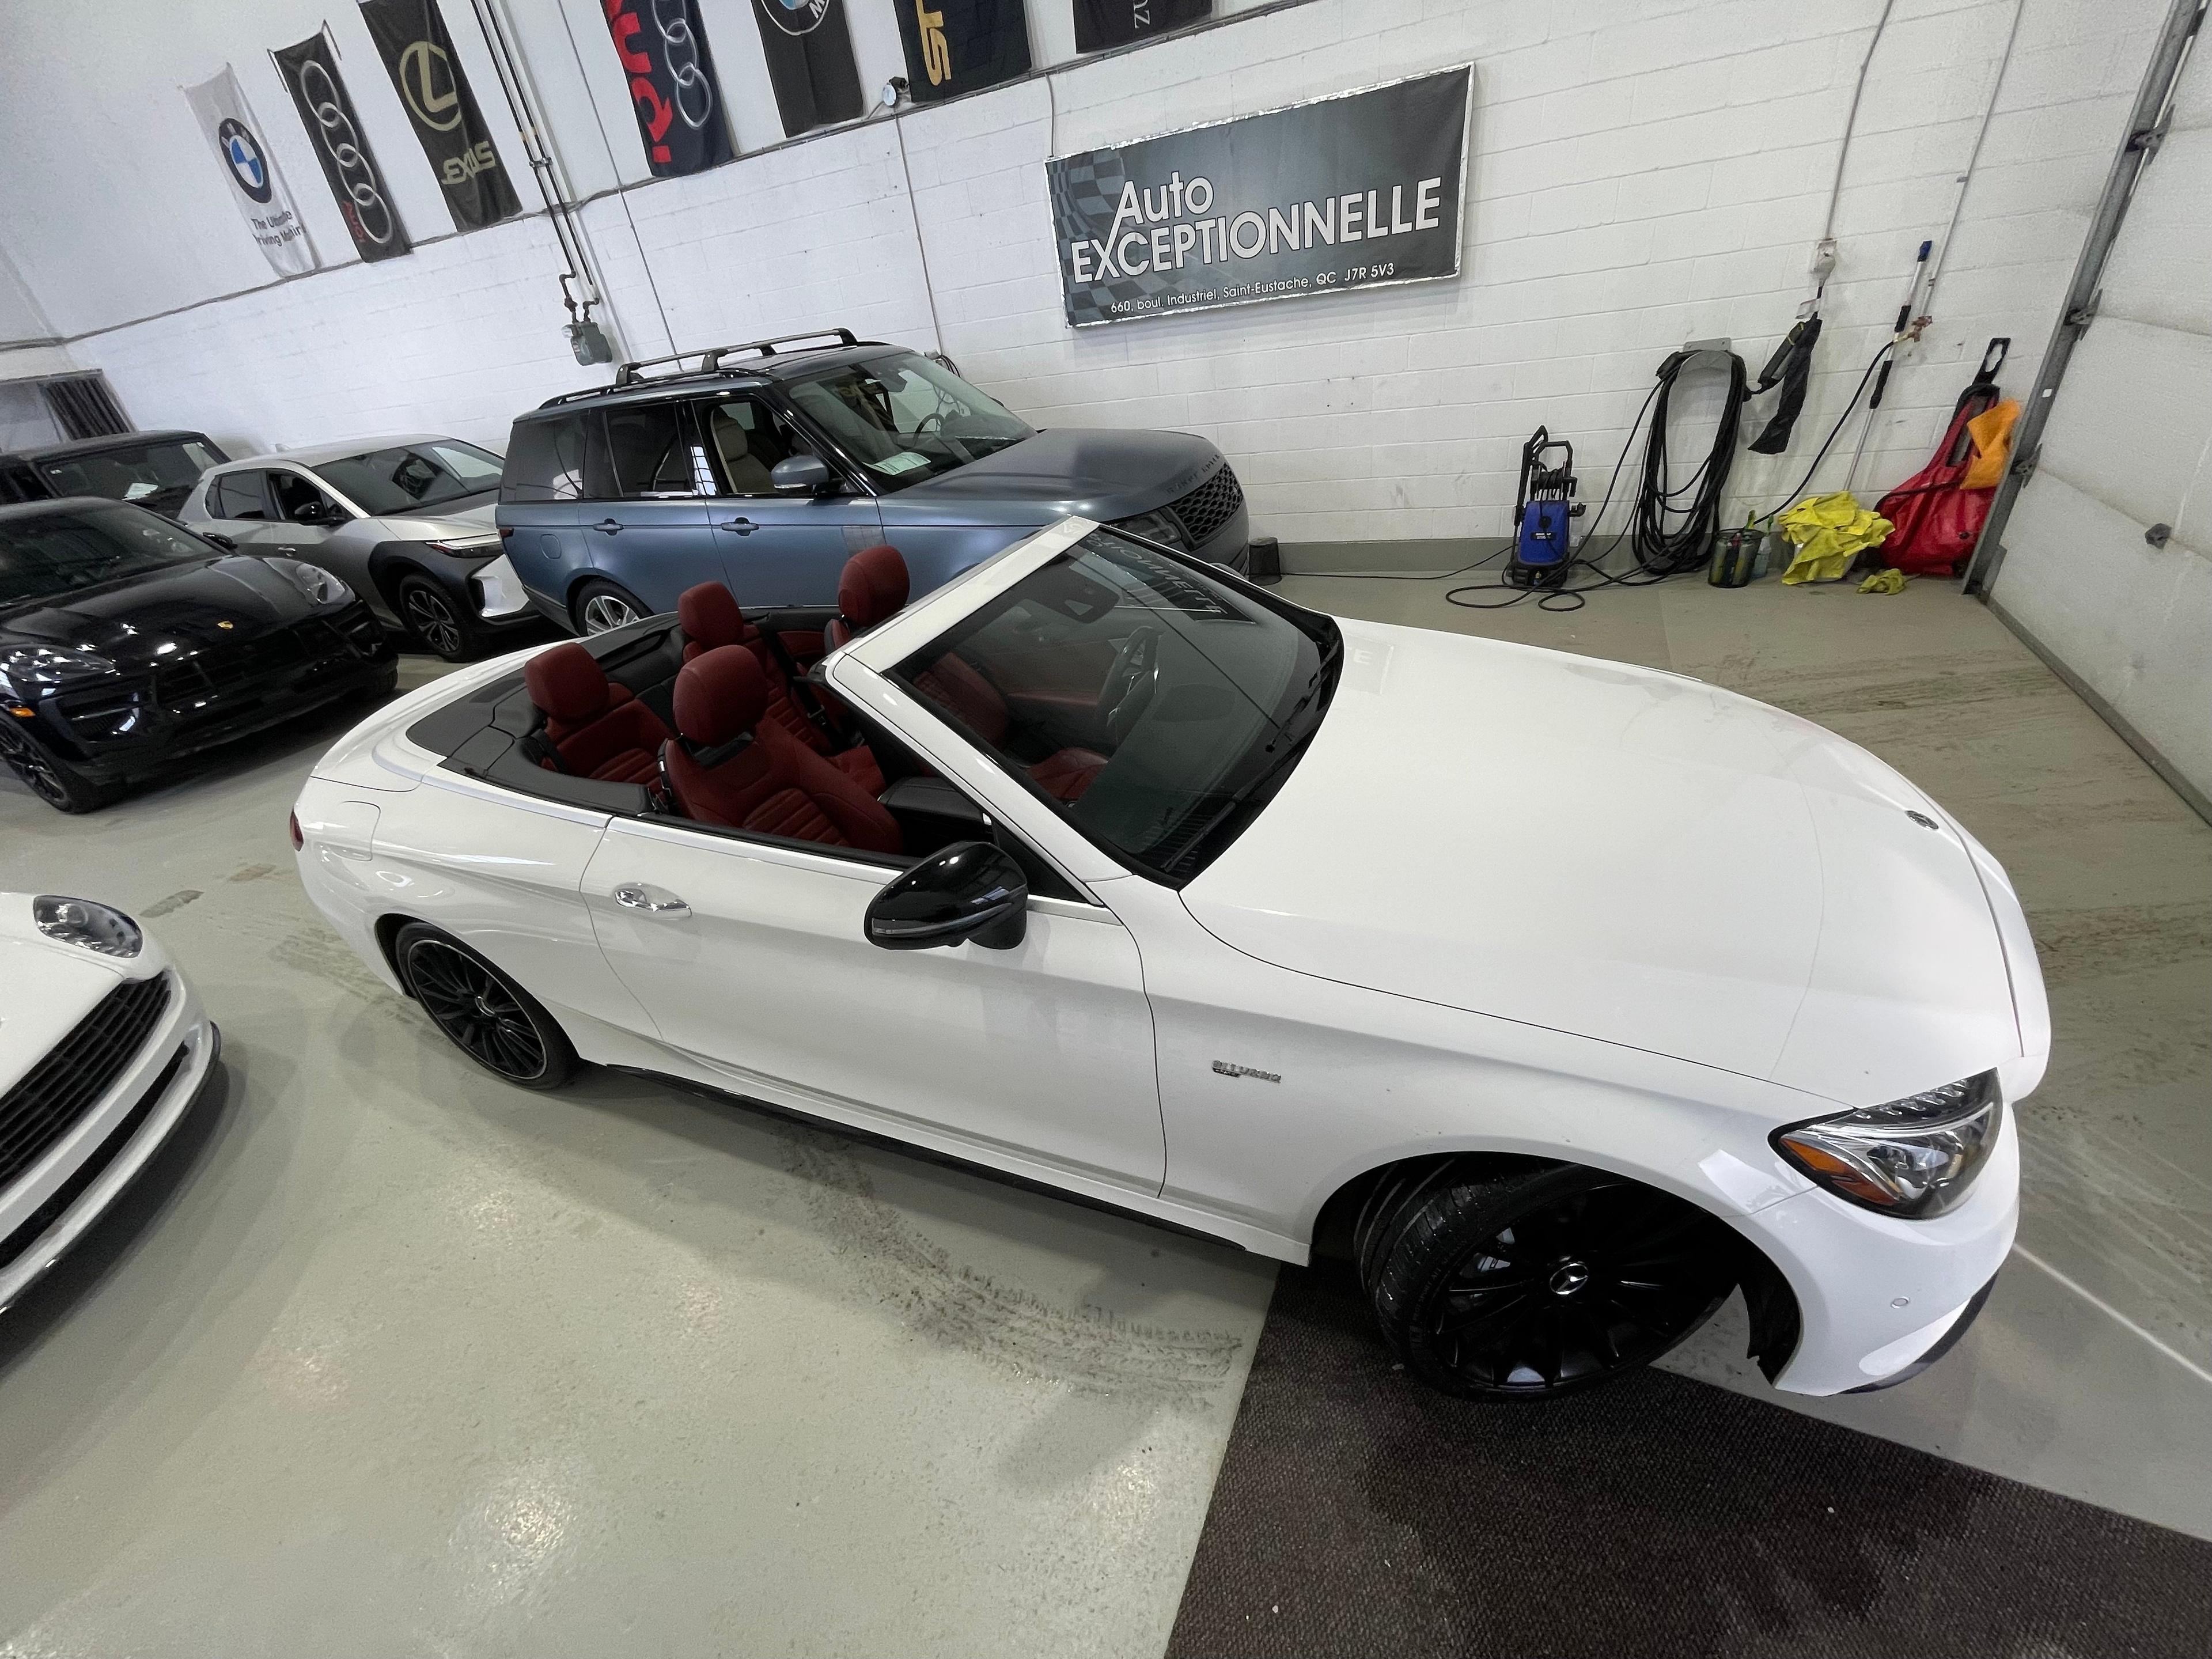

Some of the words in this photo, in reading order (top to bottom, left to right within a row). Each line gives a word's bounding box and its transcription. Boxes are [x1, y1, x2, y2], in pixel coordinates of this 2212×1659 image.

[1113, 171, 1214, 225] Auto
[1071, 177, 1441, 283] EXCEPTIONNELLE
[1111, 300, 1134, 313] 660,
[1137, 297, 1164, 309] boul.
[1167, 289, 1220, 306] Industriel,
[1223, 276, 1312, 298] Saint-Eustache,
[1316, 271, 1337, 285] QC
[1344, 267, 1367, 282] J7R
[1370, 262, 1394, 278] 5V3
